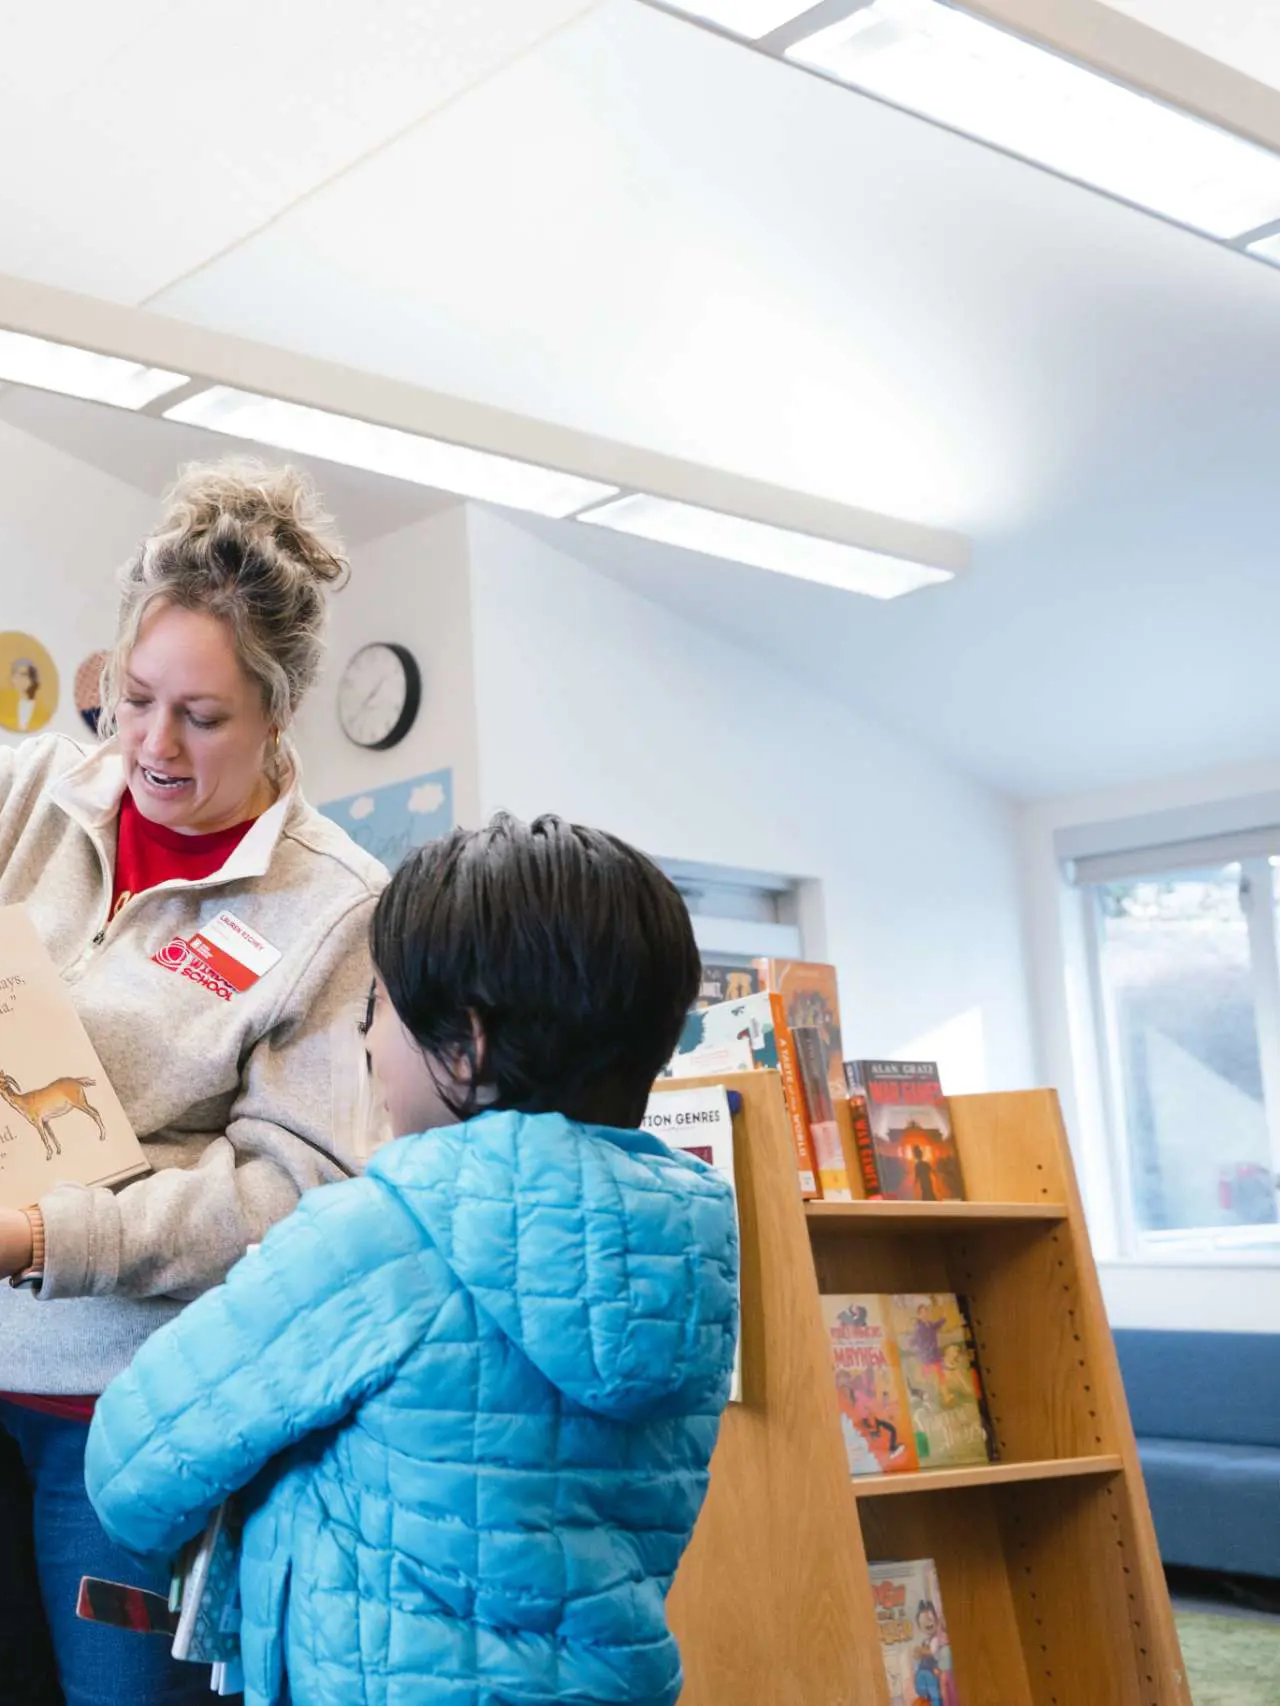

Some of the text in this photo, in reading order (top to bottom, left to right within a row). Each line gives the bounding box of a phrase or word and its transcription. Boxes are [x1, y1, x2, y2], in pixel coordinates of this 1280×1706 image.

[181, 967, 233, 1001] SCHOOL
[871, 1064, 898, 1074] ALAN
[780, 1048, 795, 1084] TASTE
[791, 1113, 806, 1157] WORLD
[675, 1110, 721, 1125] GENRES
